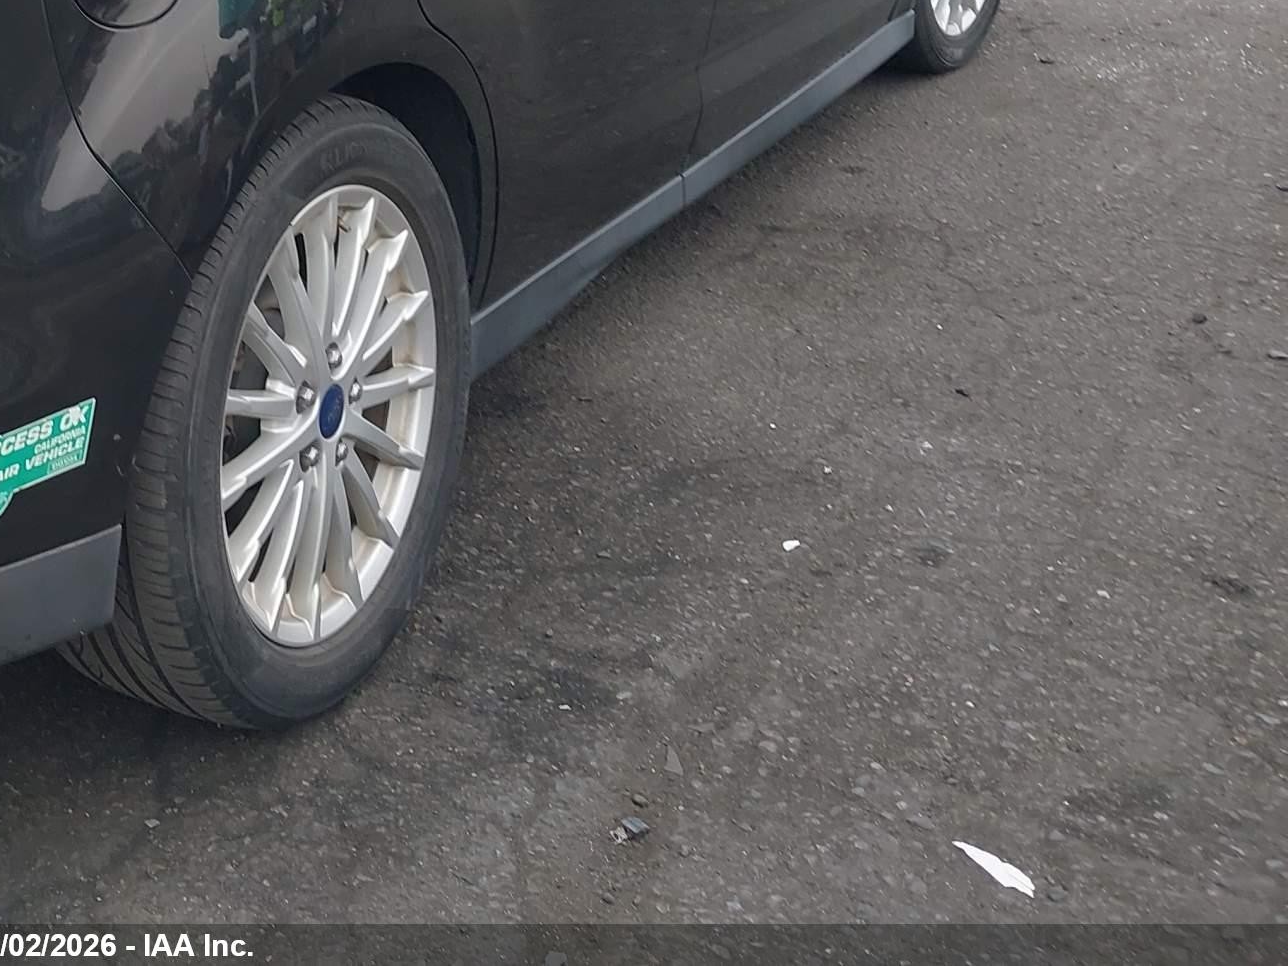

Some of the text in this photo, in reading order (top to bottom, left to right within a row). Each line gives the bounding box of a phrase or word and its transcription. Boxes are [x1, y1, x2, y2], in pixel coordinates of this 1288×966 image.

[59, 405, 89, 430] OK
[24, 436, 86, 471] VEHICLE
[34, 425, 86, 455] CALIFORNIA
